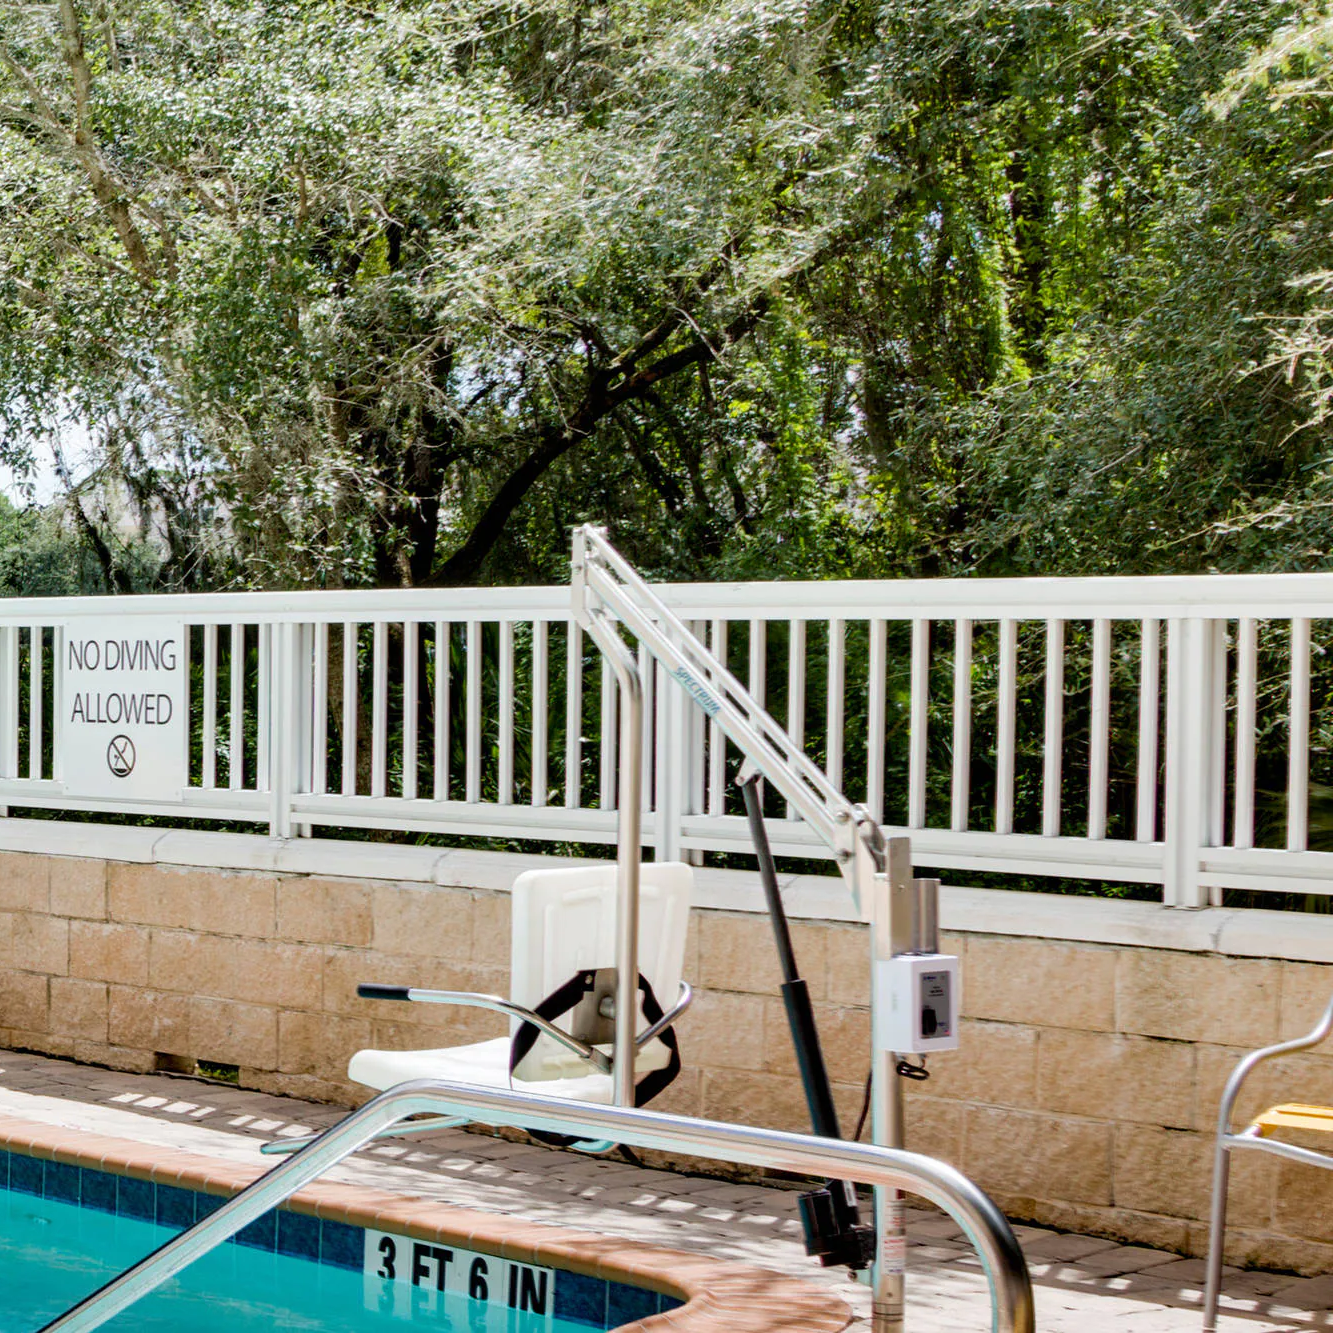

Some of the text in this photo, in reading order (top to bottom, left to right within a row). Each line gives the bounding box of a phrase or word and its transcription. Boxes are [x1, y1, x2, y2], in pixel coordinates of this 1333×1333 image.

[69, 640, 176, 670] NO DIVING
[71, 693, 173, 725] ALLOWED
[377, 1236, 547, 1315] 3 FT 6 IN
